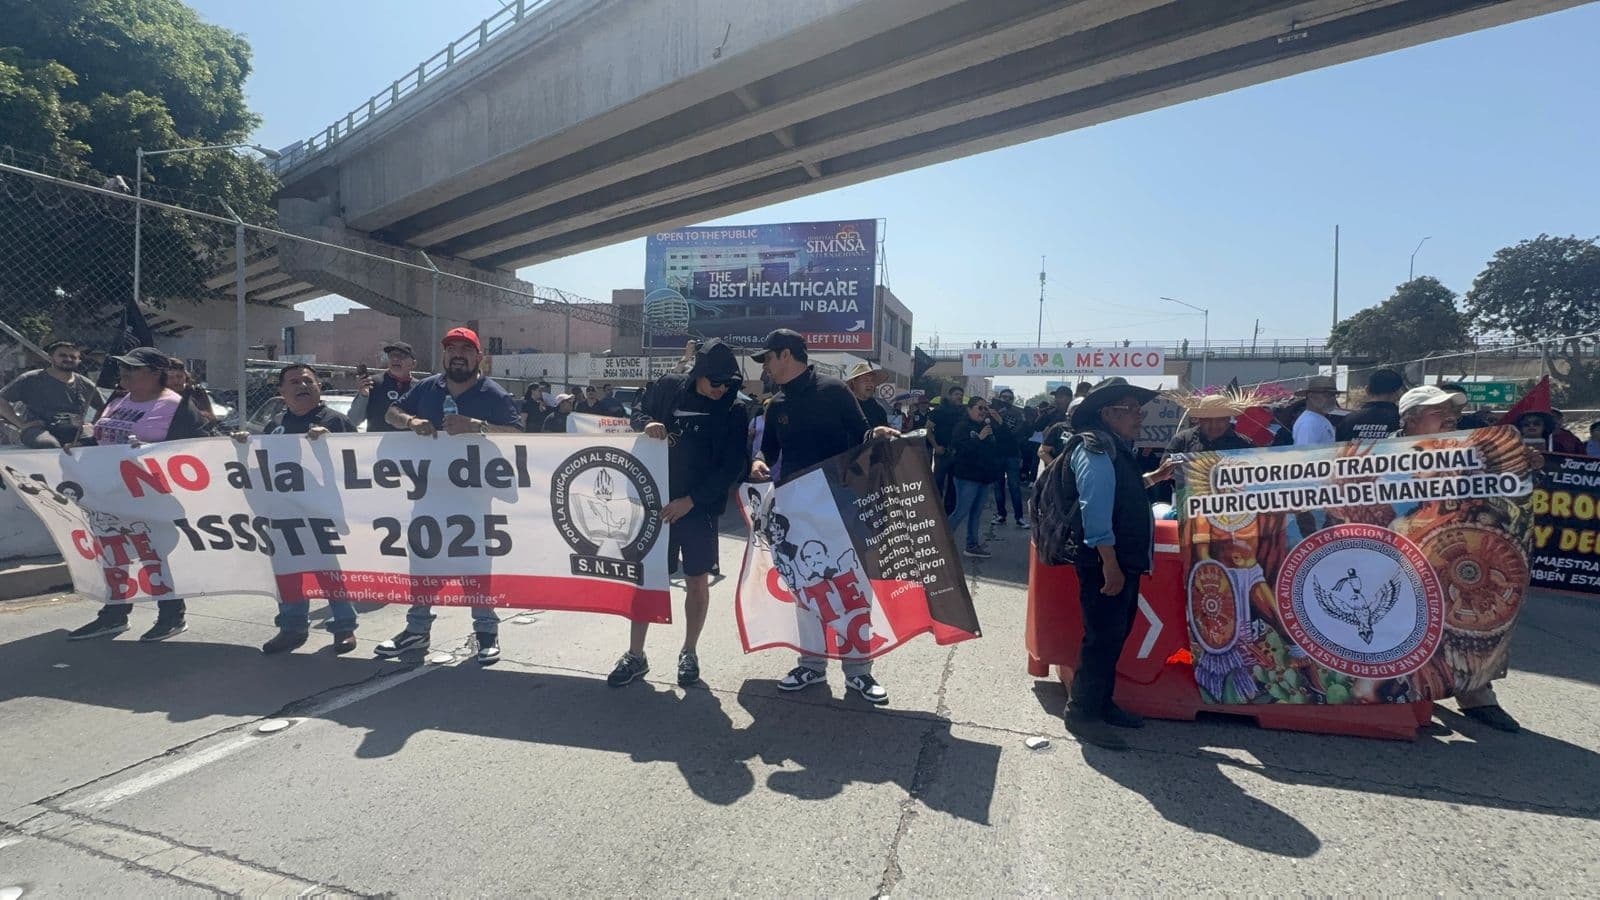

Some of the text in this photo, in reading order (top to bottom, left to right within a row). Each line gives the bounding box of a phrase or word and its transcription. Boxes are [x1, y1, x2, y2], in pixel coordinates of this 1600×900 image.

[656, 228, 758, 241] OPEN TO THE PUBLIC
[806, 238, 866, 254] SIMNSA
[709, 271, 732, 282] THE
[709, 280, 858, 298] BEST HEALTHCARE
[800, 300, 859, 313] IN BAJA
[807, 333, 860, 344] LEFT TURN
[605, 359, 640, 368] SE VENDE
[967, 350, 1160, 369] TIJUANA MÉXICO
[120, 445, 531, 500] NO a la Ley del
[1219, 449, 1479, 487] AUTORIDAD TRADICIONAL
[1560, 458, 1600, 471] Jardí
[902, 481, 923, 493] hay
[1190, 475, 1517, 516] PLURICULTURAL DE MANEADERO
[556, 452, 658, 551] POR LA EDUCACION AL SERVICIO DEL PUEBLO
[1533, 489, 1600, 519] BRO
[858, 509, 874, 522] que
[906, 509, 917, 520] la
[173, 513, 513, 559] ISSSTE 2025
[879, 543, 888, 555] se
[917, 534, 931, 544] en
[1316, 527, 1399, 547] TRADICIONAL
[1534, 525, 1553, 549] Y
[882, 567, 892, 579] en
[895, 572, 907, 584] de
[923, 574, 937, 585] de
[1280, 543, 1315, 599] AUTORIDAD
[105, 564, 174, 600] BC
[351, 574, 375, 583] eres
[422, 576, 439, 587] de
[442, 576, 481, 589] nadie,
[1400, 543, 1440, 630] PLURICULTURAL
[306, 588, 331, 598] eres
[387, 589, 402, 600] de
[404, 590, 415, 601] lo
[417, 595, 440, 606] que
[1291, 623, 1348, 669] ENSENADA
[1426, 633, 1438, 648] DE
[1352, 649, 1428, 675] MANEADERO
